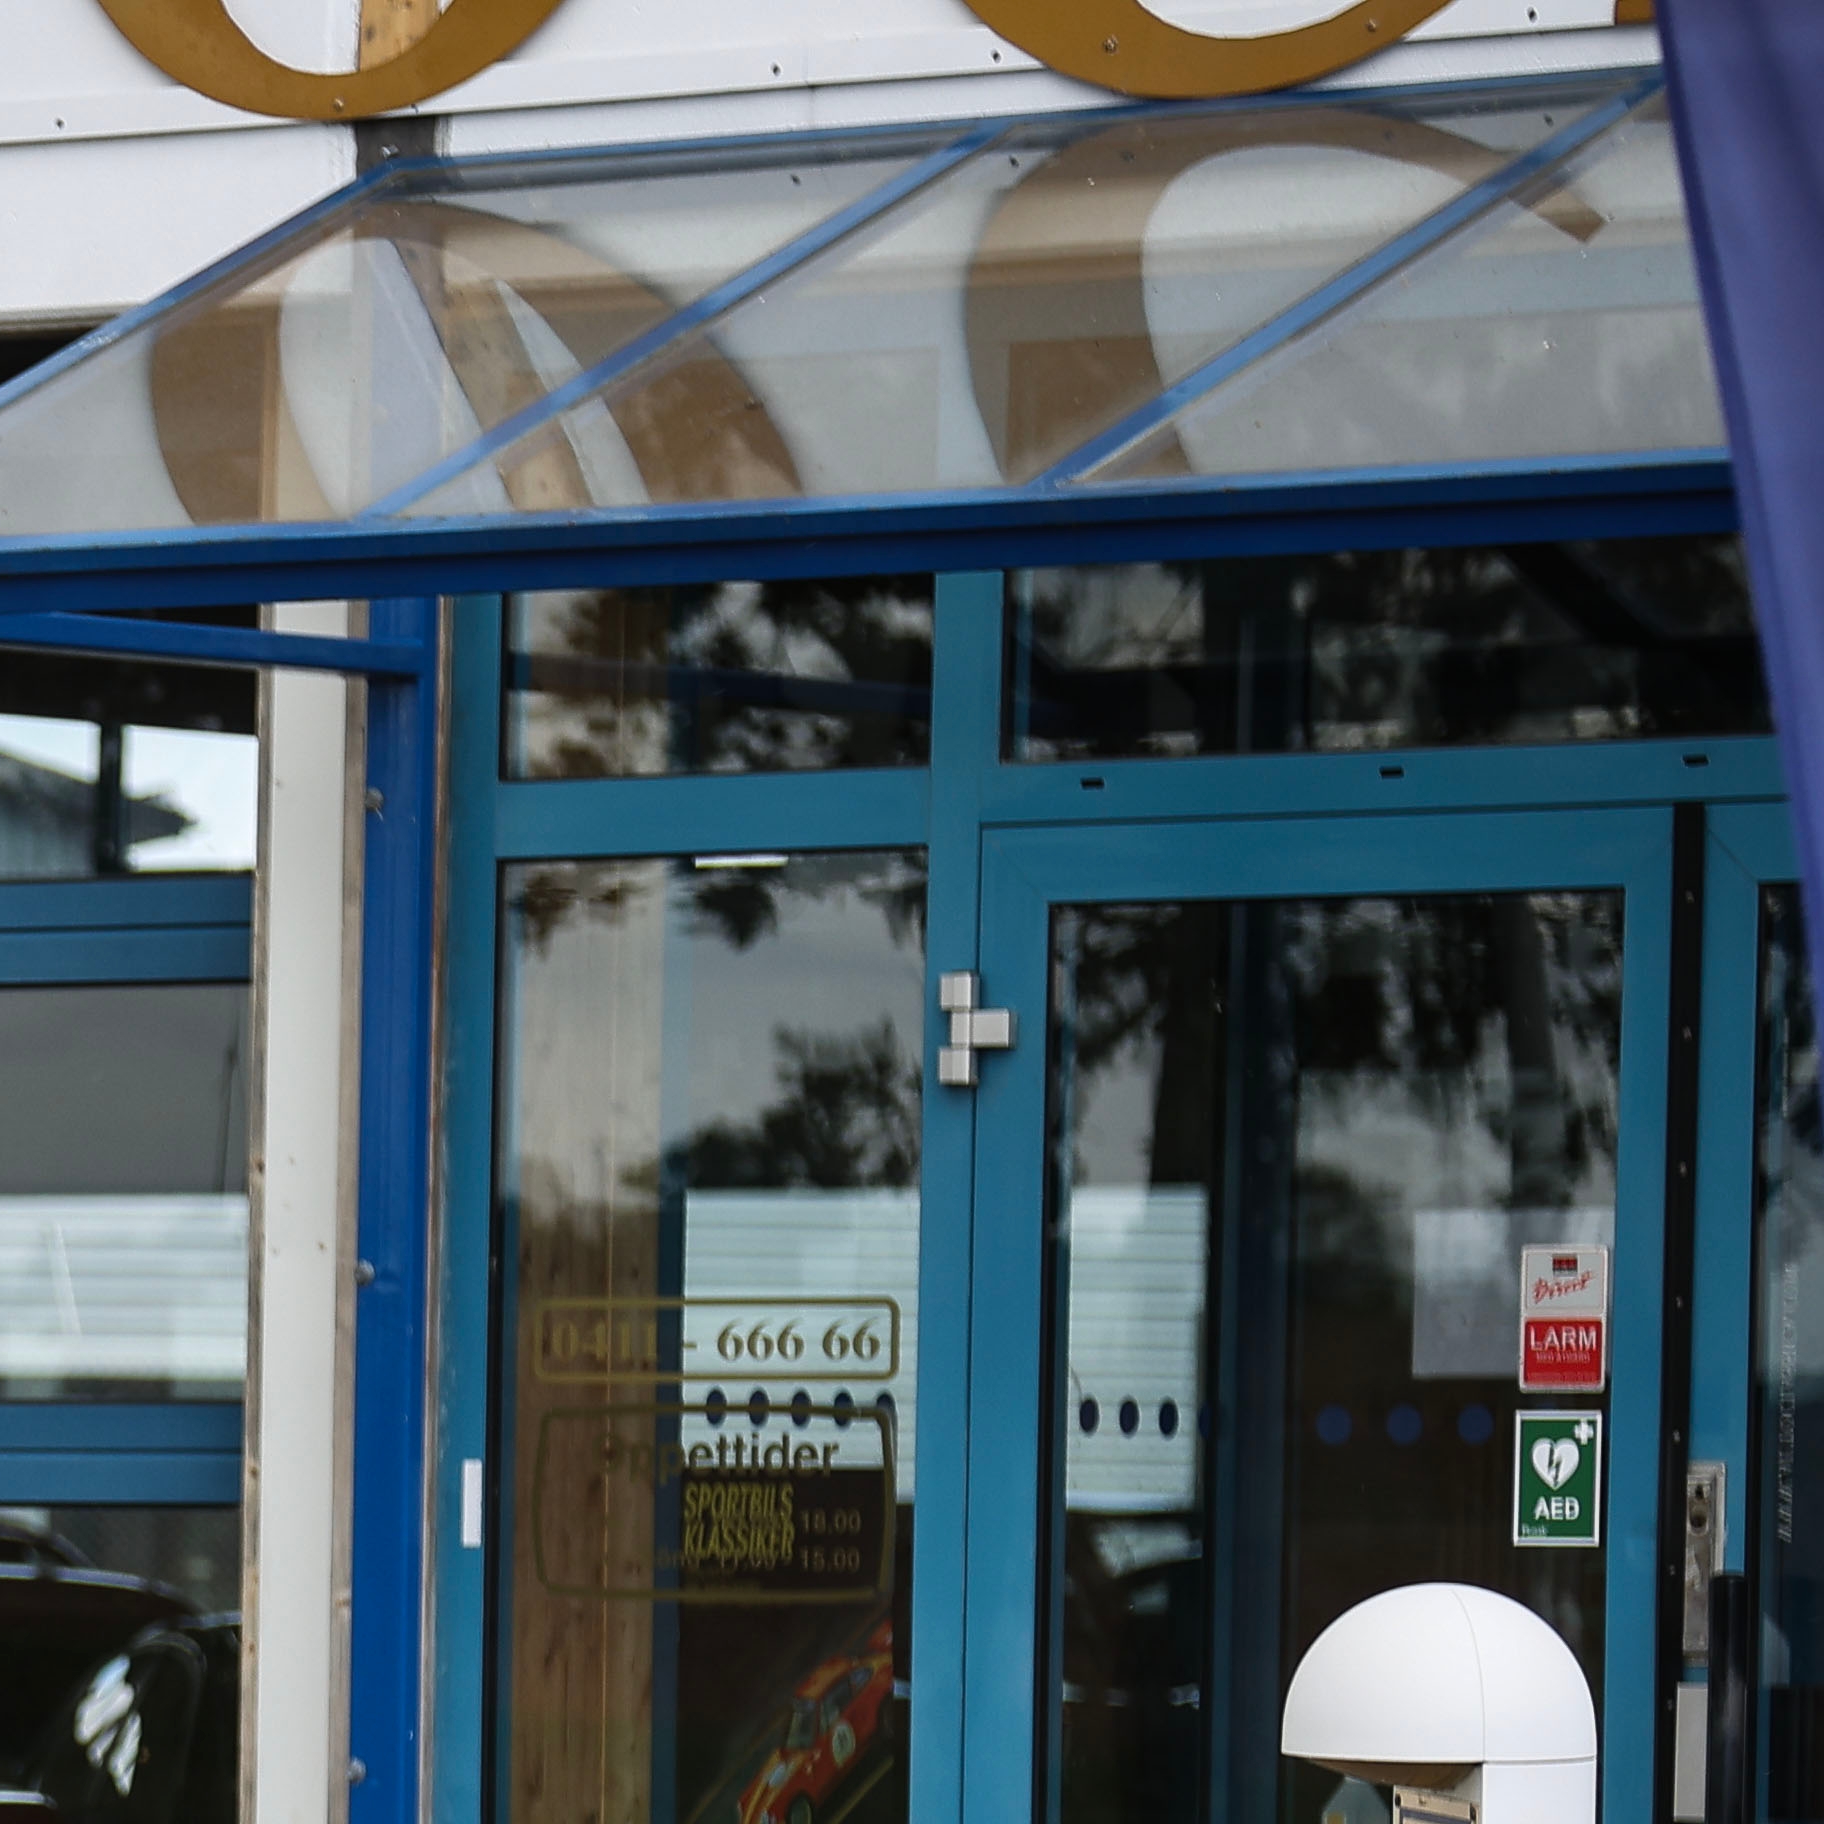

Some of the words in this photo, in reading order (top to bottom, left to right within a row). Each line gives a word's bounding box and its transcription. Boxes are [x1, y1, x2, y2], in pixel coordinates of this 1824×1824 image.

[717, 1316, 805, 1362] 666
[822, 1316, 882, 1362] 66
[1530, 1325, 1597, 1351] LARM
[598, 1430, 840, 1487] ppettider
[1534, 1495, 1581, 1521] AED
[683, 1518, 796, 1562] KLASSIKER
